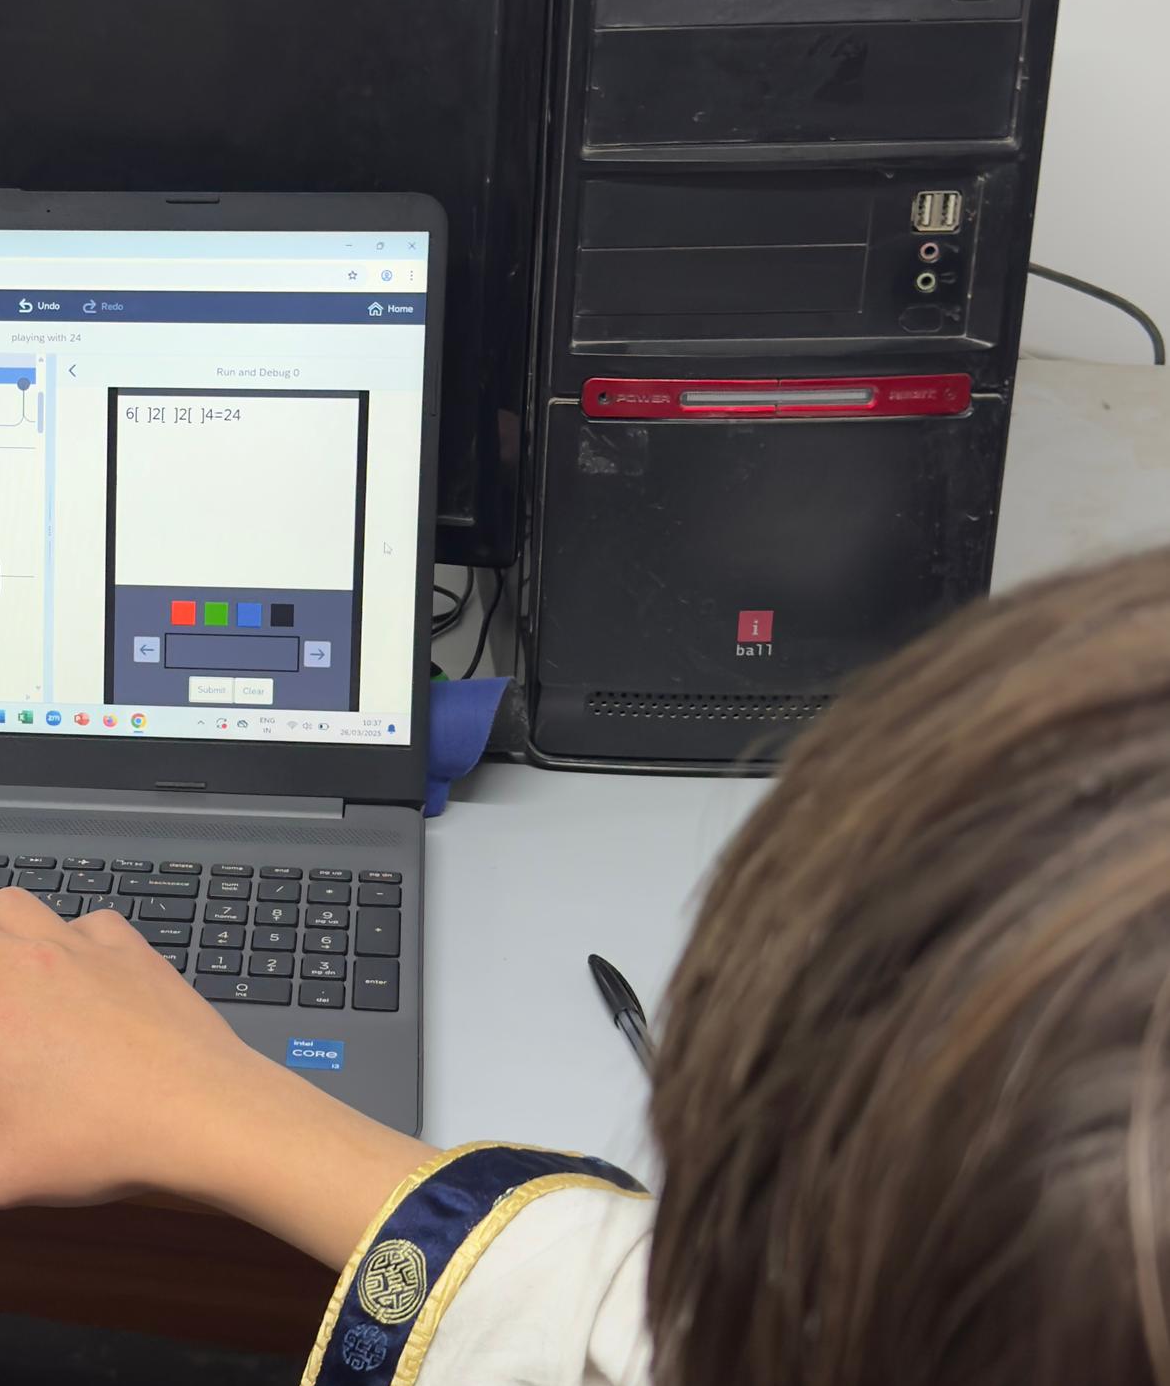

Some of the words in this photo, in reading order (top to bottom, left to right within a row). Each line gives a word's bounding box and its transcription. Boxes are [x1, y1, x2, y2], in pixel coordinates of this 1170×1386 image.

[37, 302, 60, 311] Undo
[101, 302, 124, 312] Redo
[387, 304, 414, 314] Home
[11, 333, 45, 344] playing
[47, 333, 67, 343] with
[69, 333, 82, 343] 24
[216, 367, 235, 377] Run
[238, 368, 256, 378] and
[259, 368, 290, 379] Debug
[293, 369, 300, 378] 0
[616, 394, 671, 404] POWER
[735, 643, 773, 657] ball
[197, 684, 226, 695] Submit
[242, 686, 265, 696] Clear
[259, 717, 276, 725] ENG
[263, 727, 272, 735] IN
[222, 906, 232, 914] 7
[272, 908, 283, 917] 8
[322, 911, 333, 919] 9
[217, 931, 229, 940] 4
[269, 933, 280, 942] 5
[321, 936, 332, 945] 6
[267, 959, 278, 967] 2
[319, 961, 330, 970] 3
